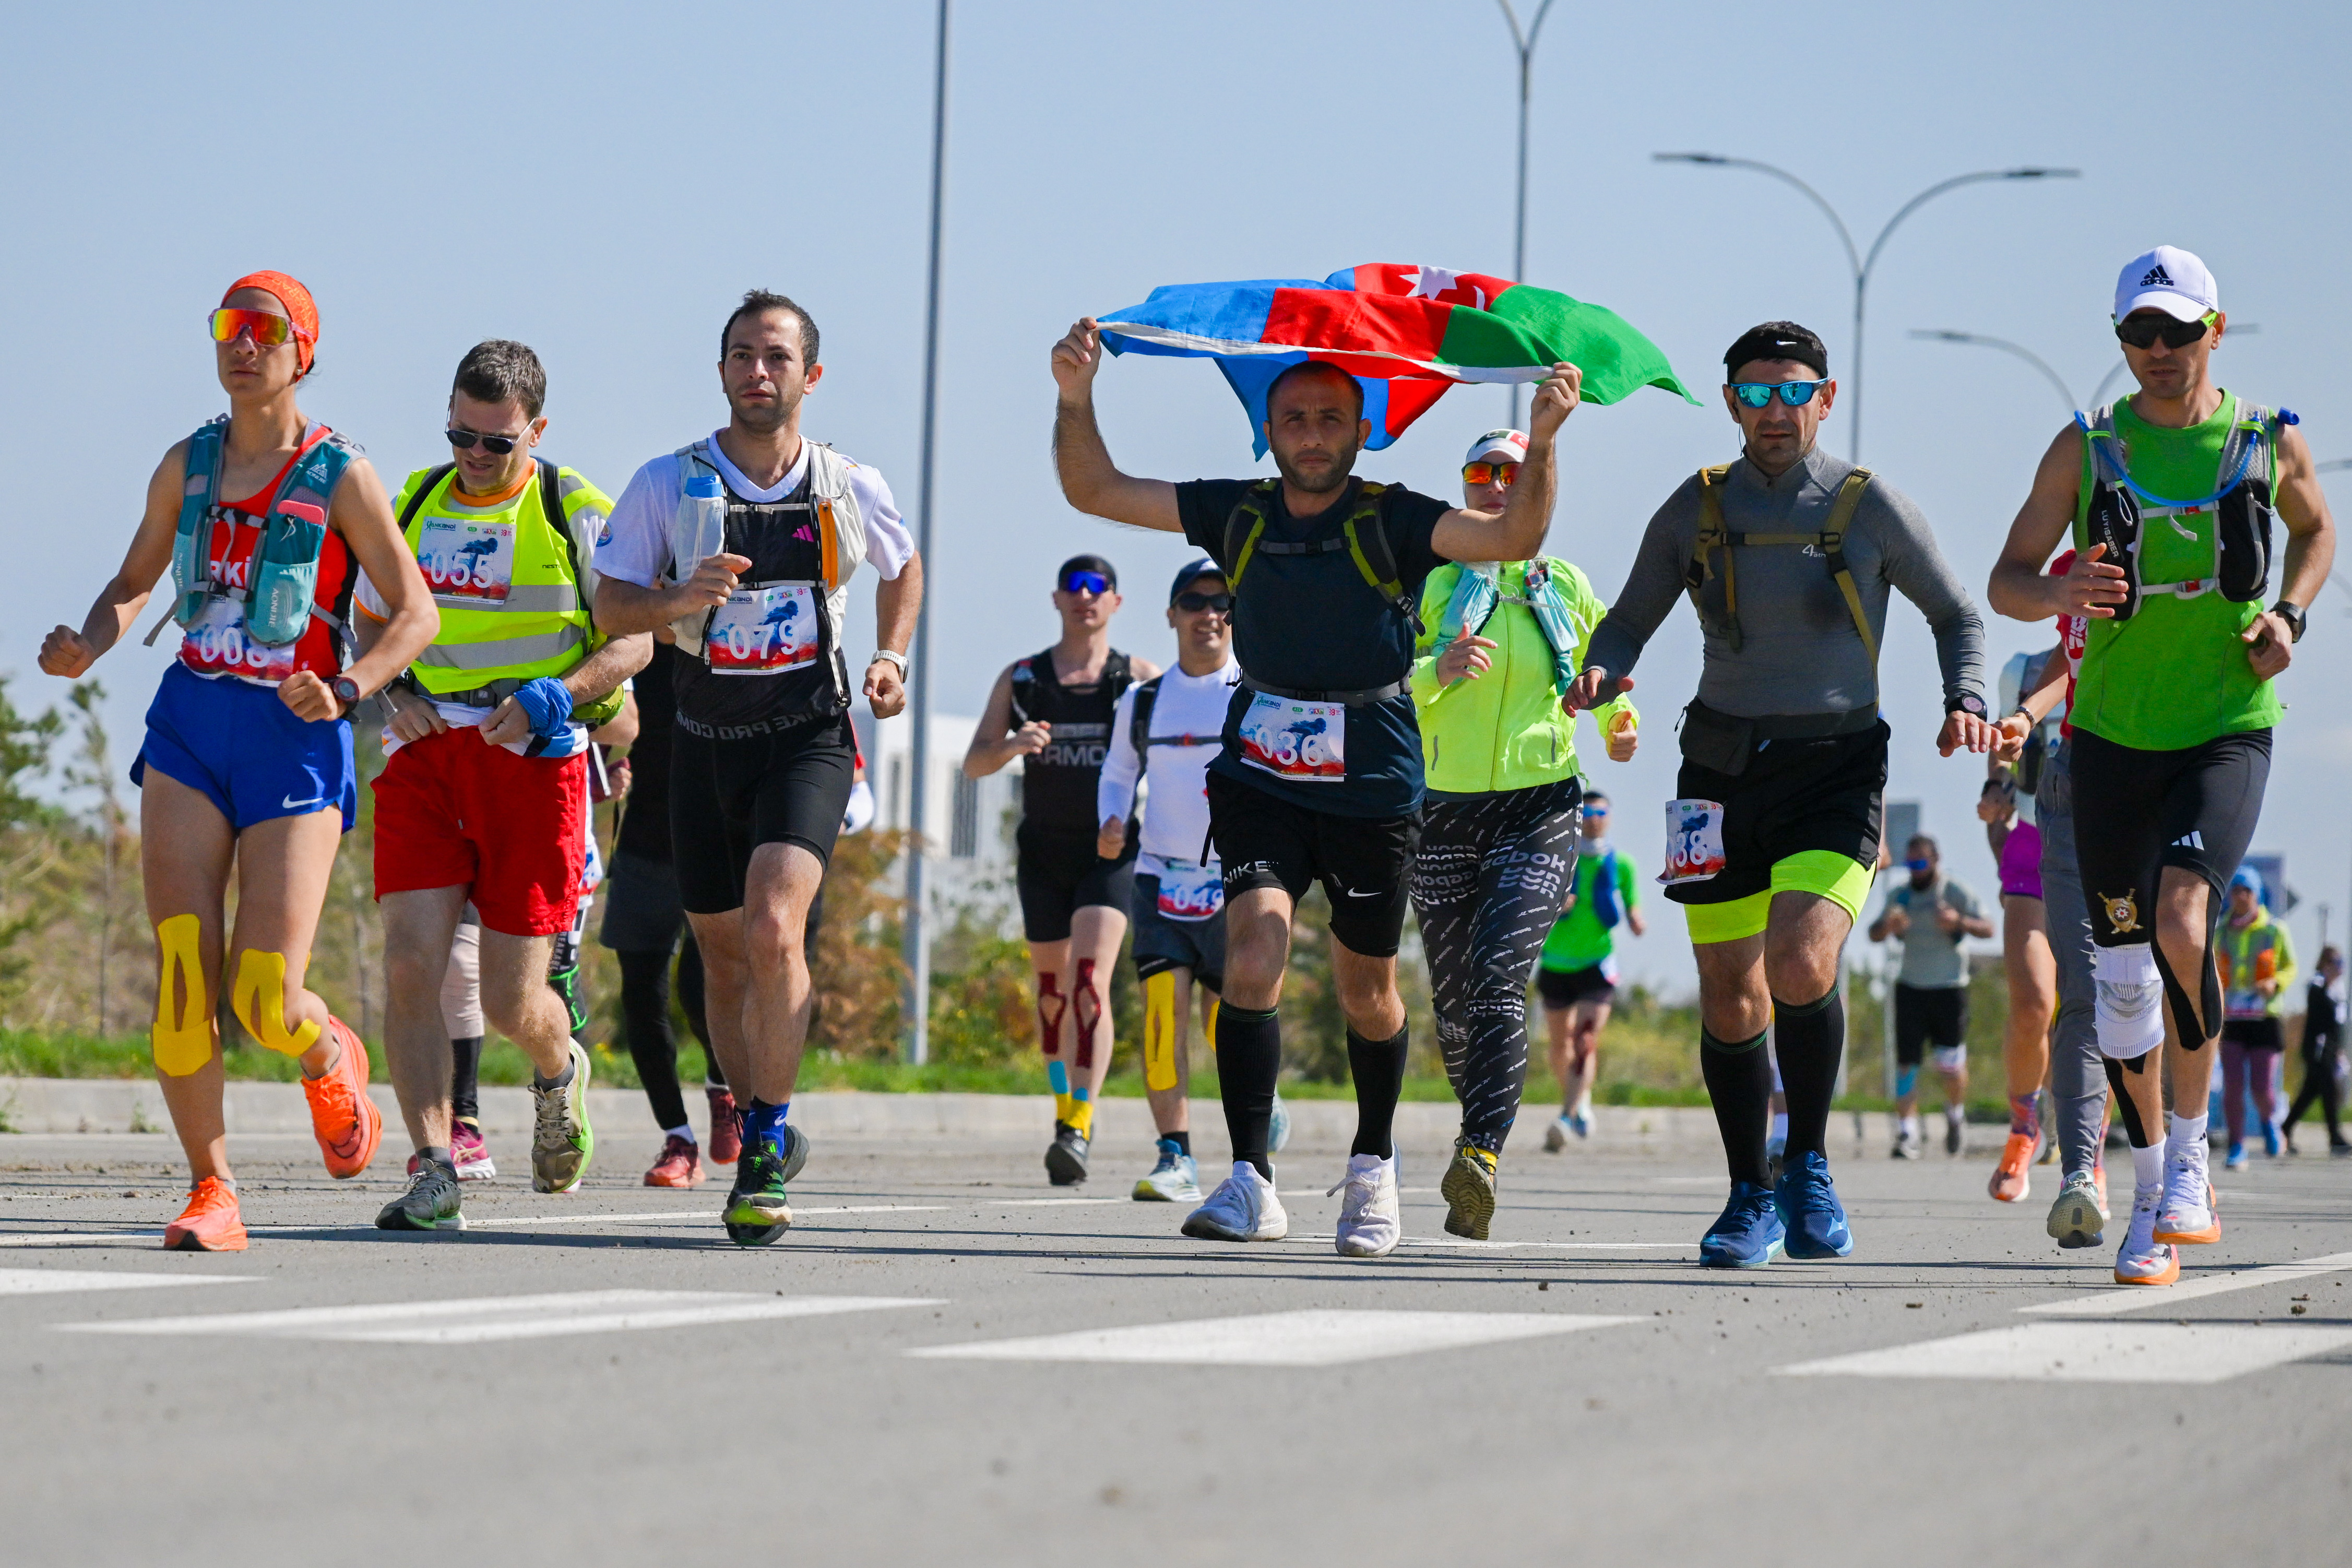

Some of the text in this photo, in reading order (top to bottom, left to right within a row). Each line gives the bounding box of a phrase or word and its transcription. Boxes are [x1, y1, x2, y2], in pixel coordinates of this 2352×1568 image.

[2141, 277, 2174, 287] adidas
[2101, 509, 2119, 558] LUYISABER
[431, 551, 494, 588] 055
[729, 620, 800, 659] 079
[1256, 727, 1324, 766] 036
[1223, 860, 1269, 889] NIKE
[1483, 1025, 1503, 1037] Reebok
[1488, 1087, 1509, 1098] Reebok
[1487, 1106, 1506, 1116] Reebok
